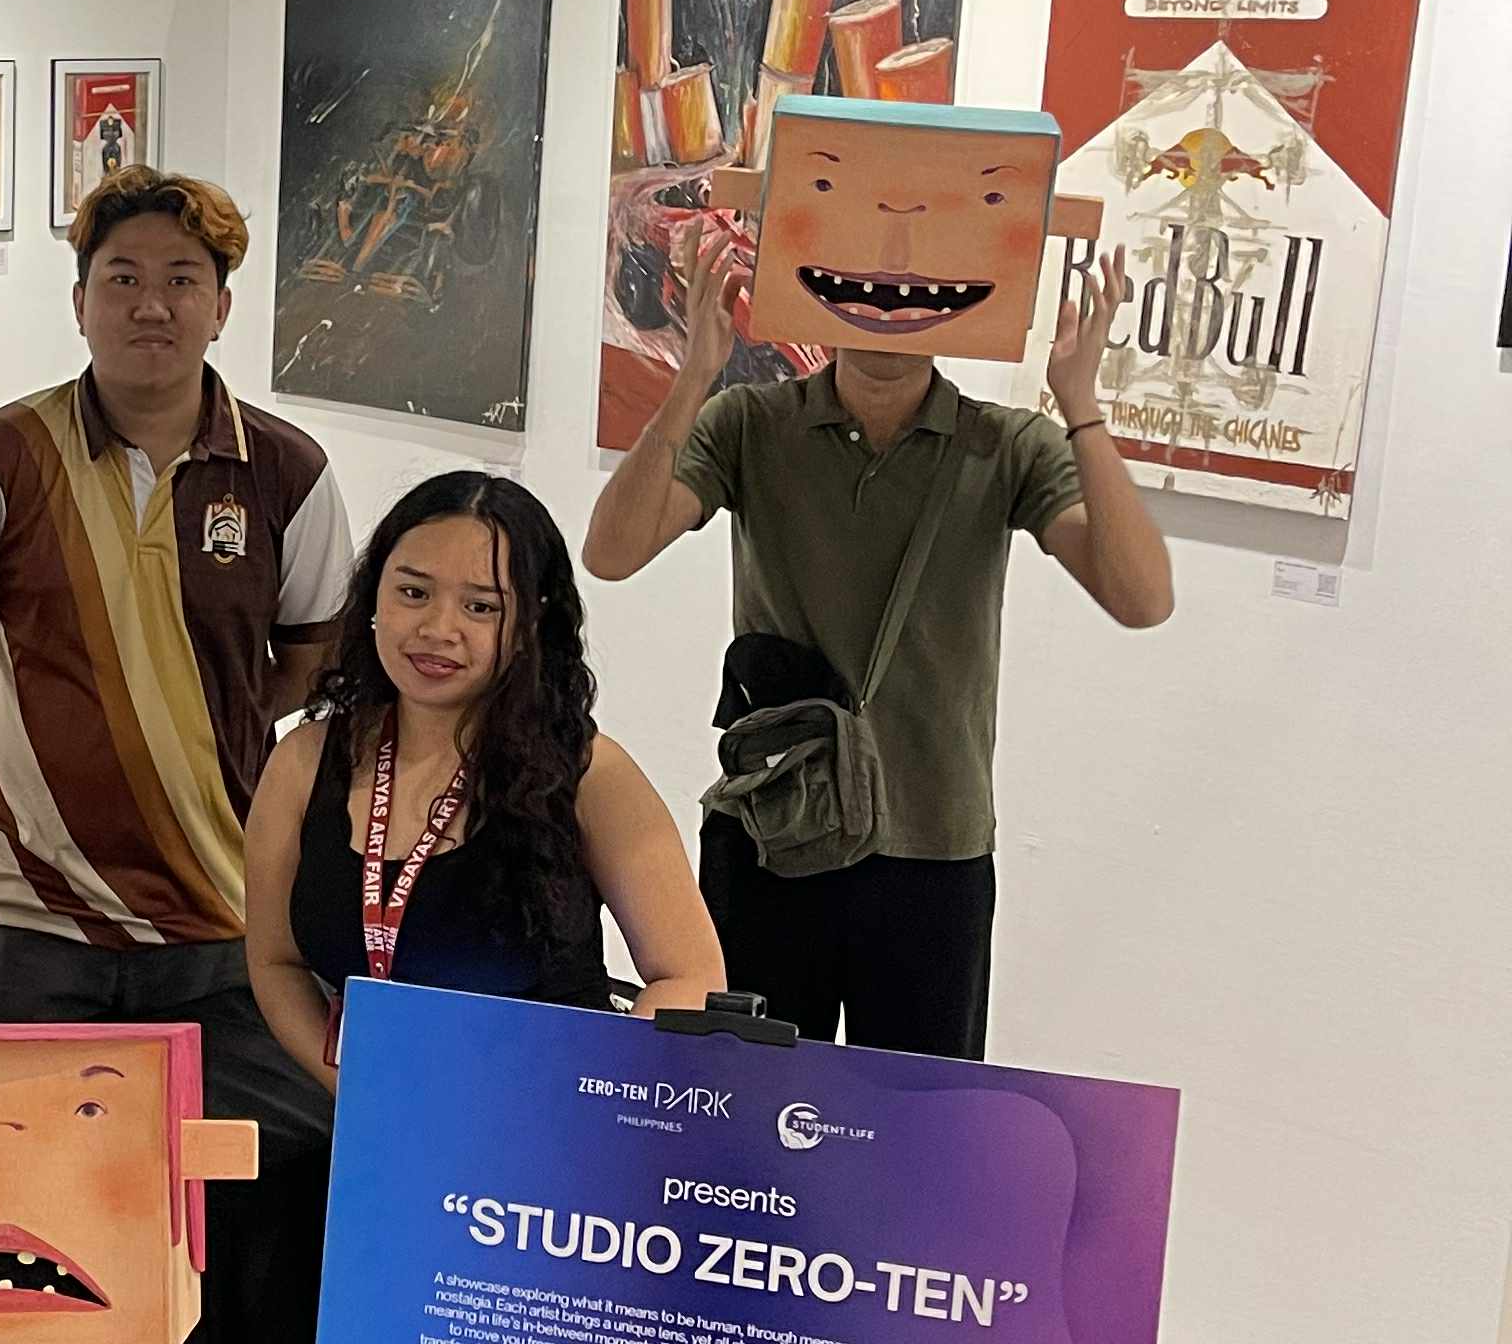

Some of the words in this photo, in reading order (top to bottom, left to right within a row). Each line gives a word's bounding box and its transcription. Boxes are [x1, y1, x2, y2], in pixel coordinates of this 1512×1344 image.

[1237, 0, 1299, 15] LIMITS
[1111, 400, 1182, 438] THROUGH
[1224, 415, 1304, 452] CHICANES
[371, 741, 392, 817] VISAYAS
[367, 822, 386, 857] ART
[389, 832, 438, 908] VISAYAS
[431, 791, 460, 831] ART
[363, 861, 380, 906] FAIR
[578, 1077, 647, 1100] ZERO-TEN
[654, 1082, 731, 1118] PARK
[617, 1114, 682, 1132] PHILIPPINES
[792, 1120, 844, 1134] STUDENT
[849, 1128, 874, 1139] LIFE
[663, 1178, 795, 1216] presents
[424, 1304, 477, 1325] meaning
[478, 1310, 489, 1324] in
[434, 1271, 444, 1284] A
[446, 1274, 509, 1295] showcase
[511, 1287, 569, 1309] exploring
[571, 1296, 602, 1311] what
[604, 1299, 612, 1313] it
[614, 1304, 658, 1320] means
[661, 1309, 674, 1323] to
[676, 1311, 695, 1326] be
